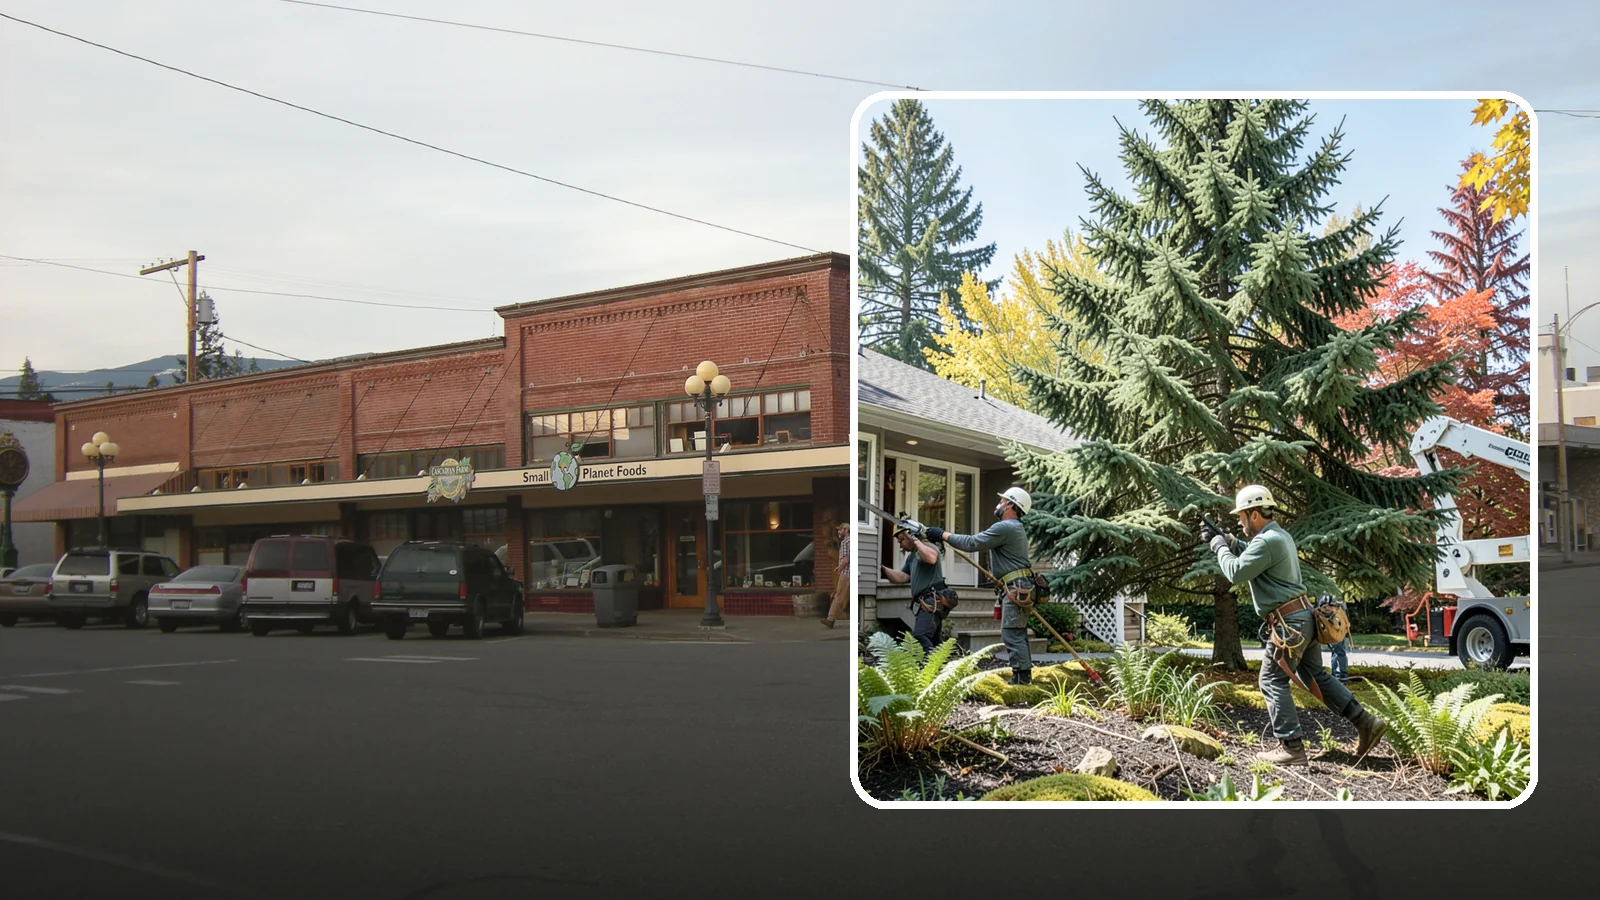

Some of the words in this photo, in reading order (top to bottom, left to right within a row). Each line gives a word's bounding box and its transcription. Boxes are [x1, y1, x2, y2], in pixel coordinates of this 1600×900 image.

[523, 471, 548, 482] Small
[583, 468, 614, 479] Planet
[617, 464, 646, 476] Foods
